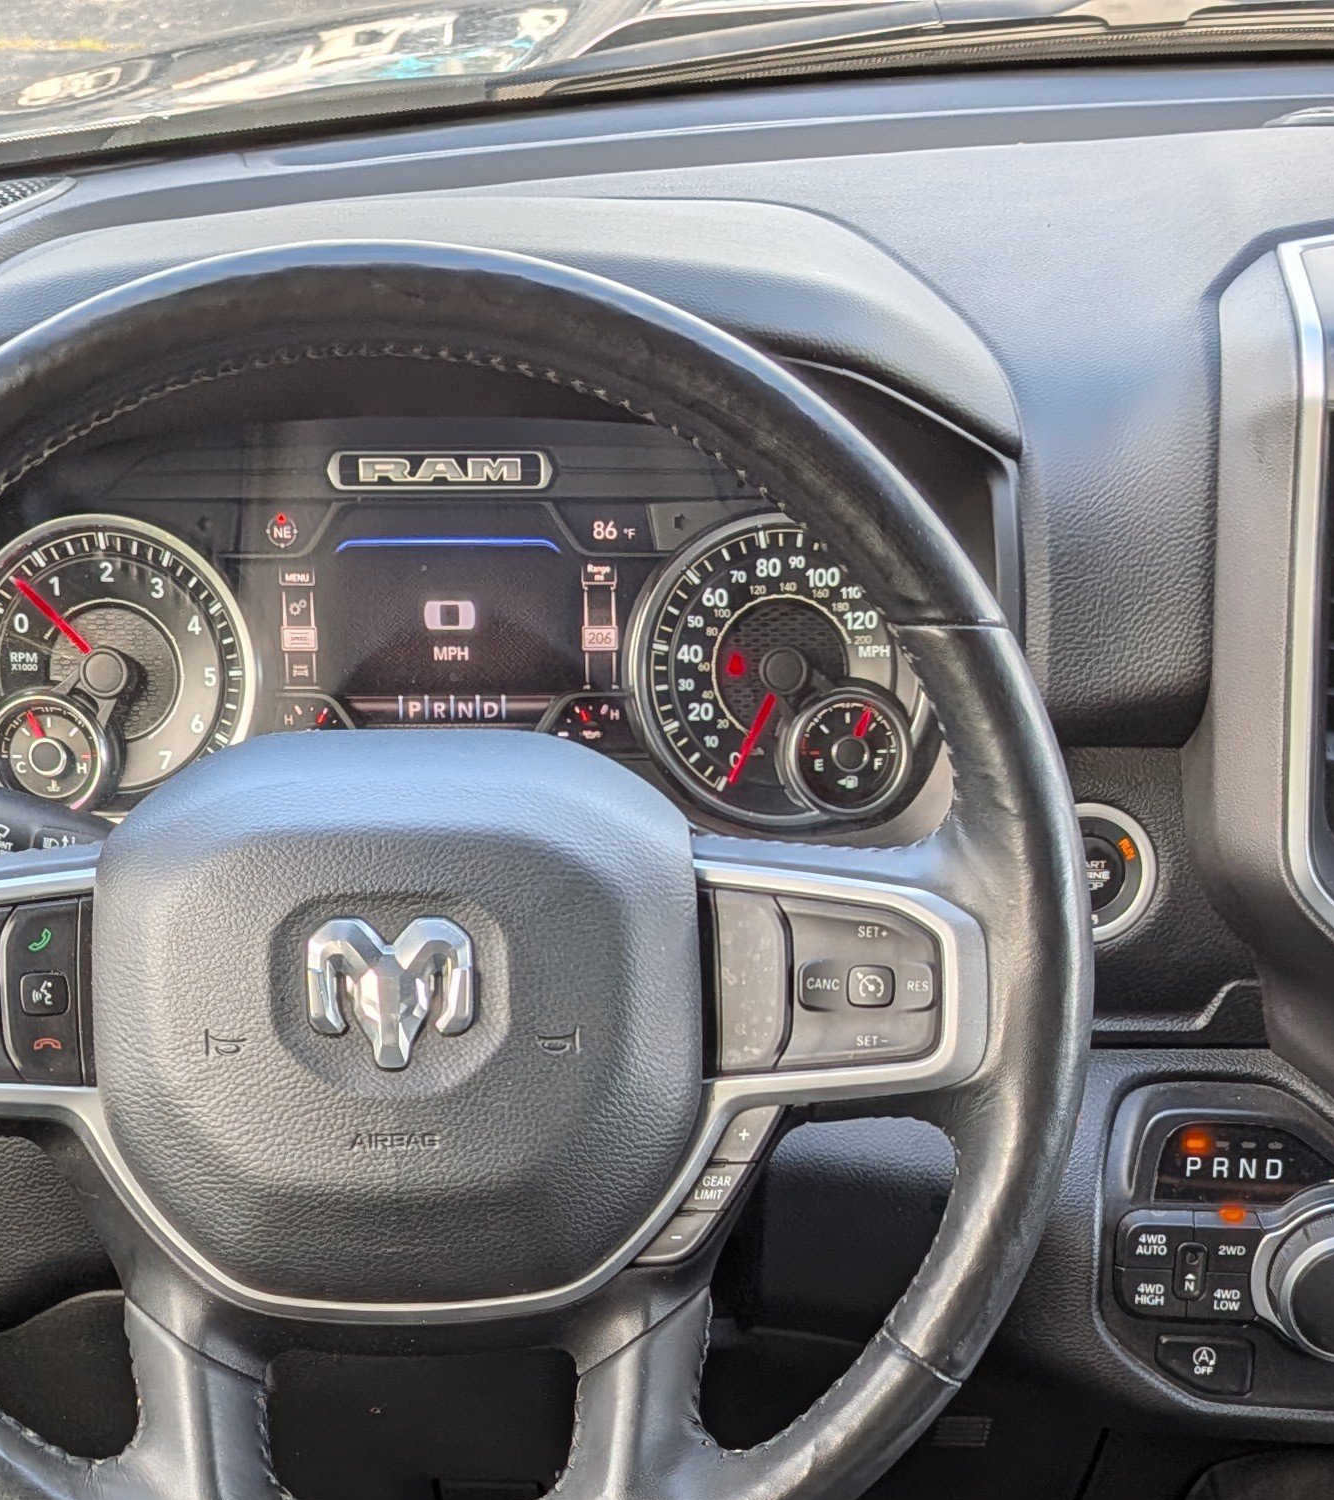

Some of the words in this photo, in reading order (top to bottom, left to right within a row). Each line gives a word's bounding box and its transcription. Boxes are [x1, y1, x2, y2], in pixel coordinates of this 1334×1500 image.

[358, 457, 521, 481] RAM
[273, 526, 291, 539] NE
[592, 521, 617, 540] 86
[756, 558, 781, 578] 80
[789, 555, 805, 569] 90
[100, 563, 115, 582] 2
[285, 573, 309, 583] MENU
[730, 571, 747, 584] 70
[806, 567, 840, 588] 100
[49, 577, 61, 596] 1
[150, 579, 165, 598] 3
[749, 584, 767, 595] 120
[779, 582, 797, 592] 140
[702, 588, 728, 608] 60
[812, 588, 830, 599] 160
[713, 608, 731, 619] 100
[14, 614, 29, 634] 0
[187, 615, 202, 635] 4
[687, 615, 703, 628] 50
[843, 611, 878, 630] 120
[588, 632, 612, 645] 206
[854, 634, 872, 645] 200
[10, 652, 38, 663] RPM
[434, 646, 469, 662] MPH
[677, 644, 703, 664] 40
[858, 645, 890, 658] MPH
[203, 668, 217, 688] 5
[678, 678, 695, 692] 30
[408, 702, 421, 720] P
[434, 702, 447, 720] R
[458, 702, 473, 720] N
[484, 702, 498, 720] D
[688, 702, 714, 722] 20
[190, 714, 205, 734] 6
[704, 735, 719, 748] 10
[159, 751, 173, 770] 7
[814, 758, 824, 772] E
[873, 758, 883, 771] F
[16, 762, 26, 774] C
[76, 762, 87, 774] H
[806, 977, 840, 991] CANC
[907, 980, 929, 992] RES
[347, 1133, 441, 1150] AIRBAG
[1186, 1157, 1201, 1178] P
[1213, 1157, 1229, 1178] R
[1239, 1158, 1256, 1179] N
[1266, 1158, 1283, 1180] D
[702, 1176, 732, 1188] GEAR
[694, 1189, 723, 1201] LIMIT
[1139, 1234, 1166, 1246] 4WD
[1135, 1245, 1167, 1257] AUTO
[1218, 1245, 1246, 1256] 2WD
[1137, 1283, 1164, 1295] 4WD
[1184, 1280, 1195, 1292] N
[1135, 1294, 1165, 1306] HIGH
[1213, 1288, 1241, 1300] 4WD
[1213, 1300, 1240, 1311] LOW
[1194, 1365, 1213, 1376] OFF
